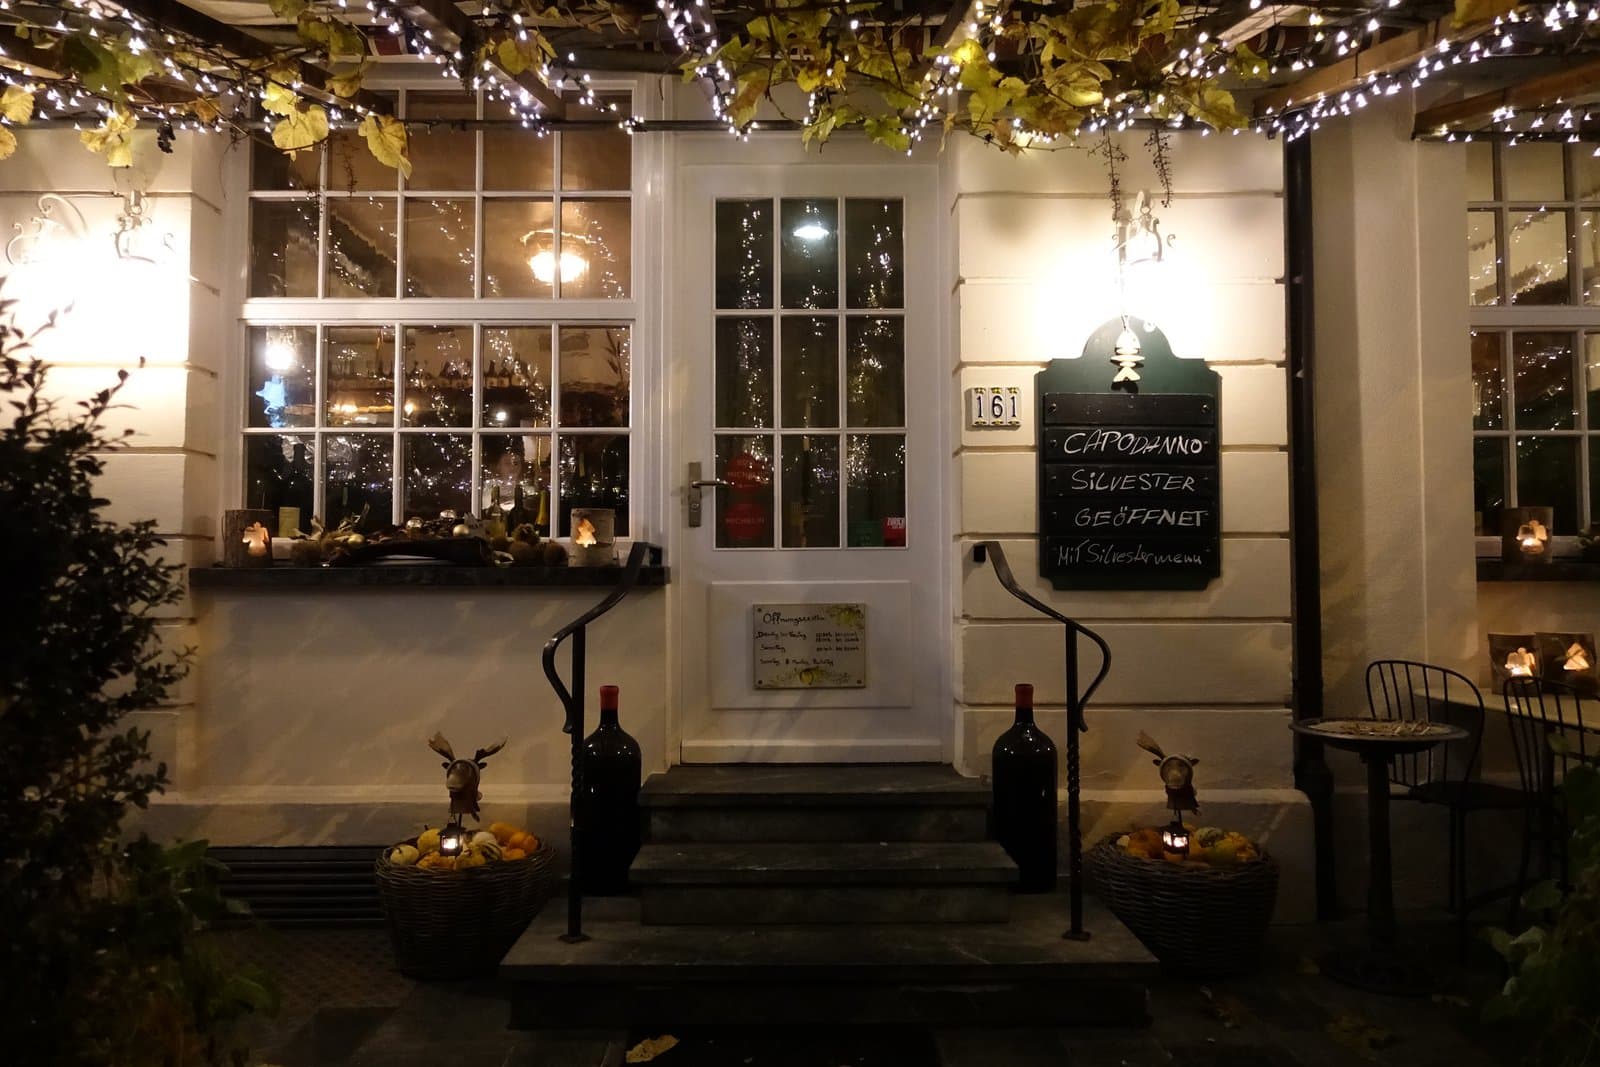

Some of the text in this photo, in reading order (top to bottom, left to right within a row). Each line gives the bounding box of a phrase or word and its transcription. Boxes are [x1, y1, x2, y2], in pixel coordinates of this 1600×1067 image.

[976, 394, 1017, 418] 161
[1063, 428, 1204, 456] CAPODANNO
[1074, 505, 1207, 528] GEÖFFNET
